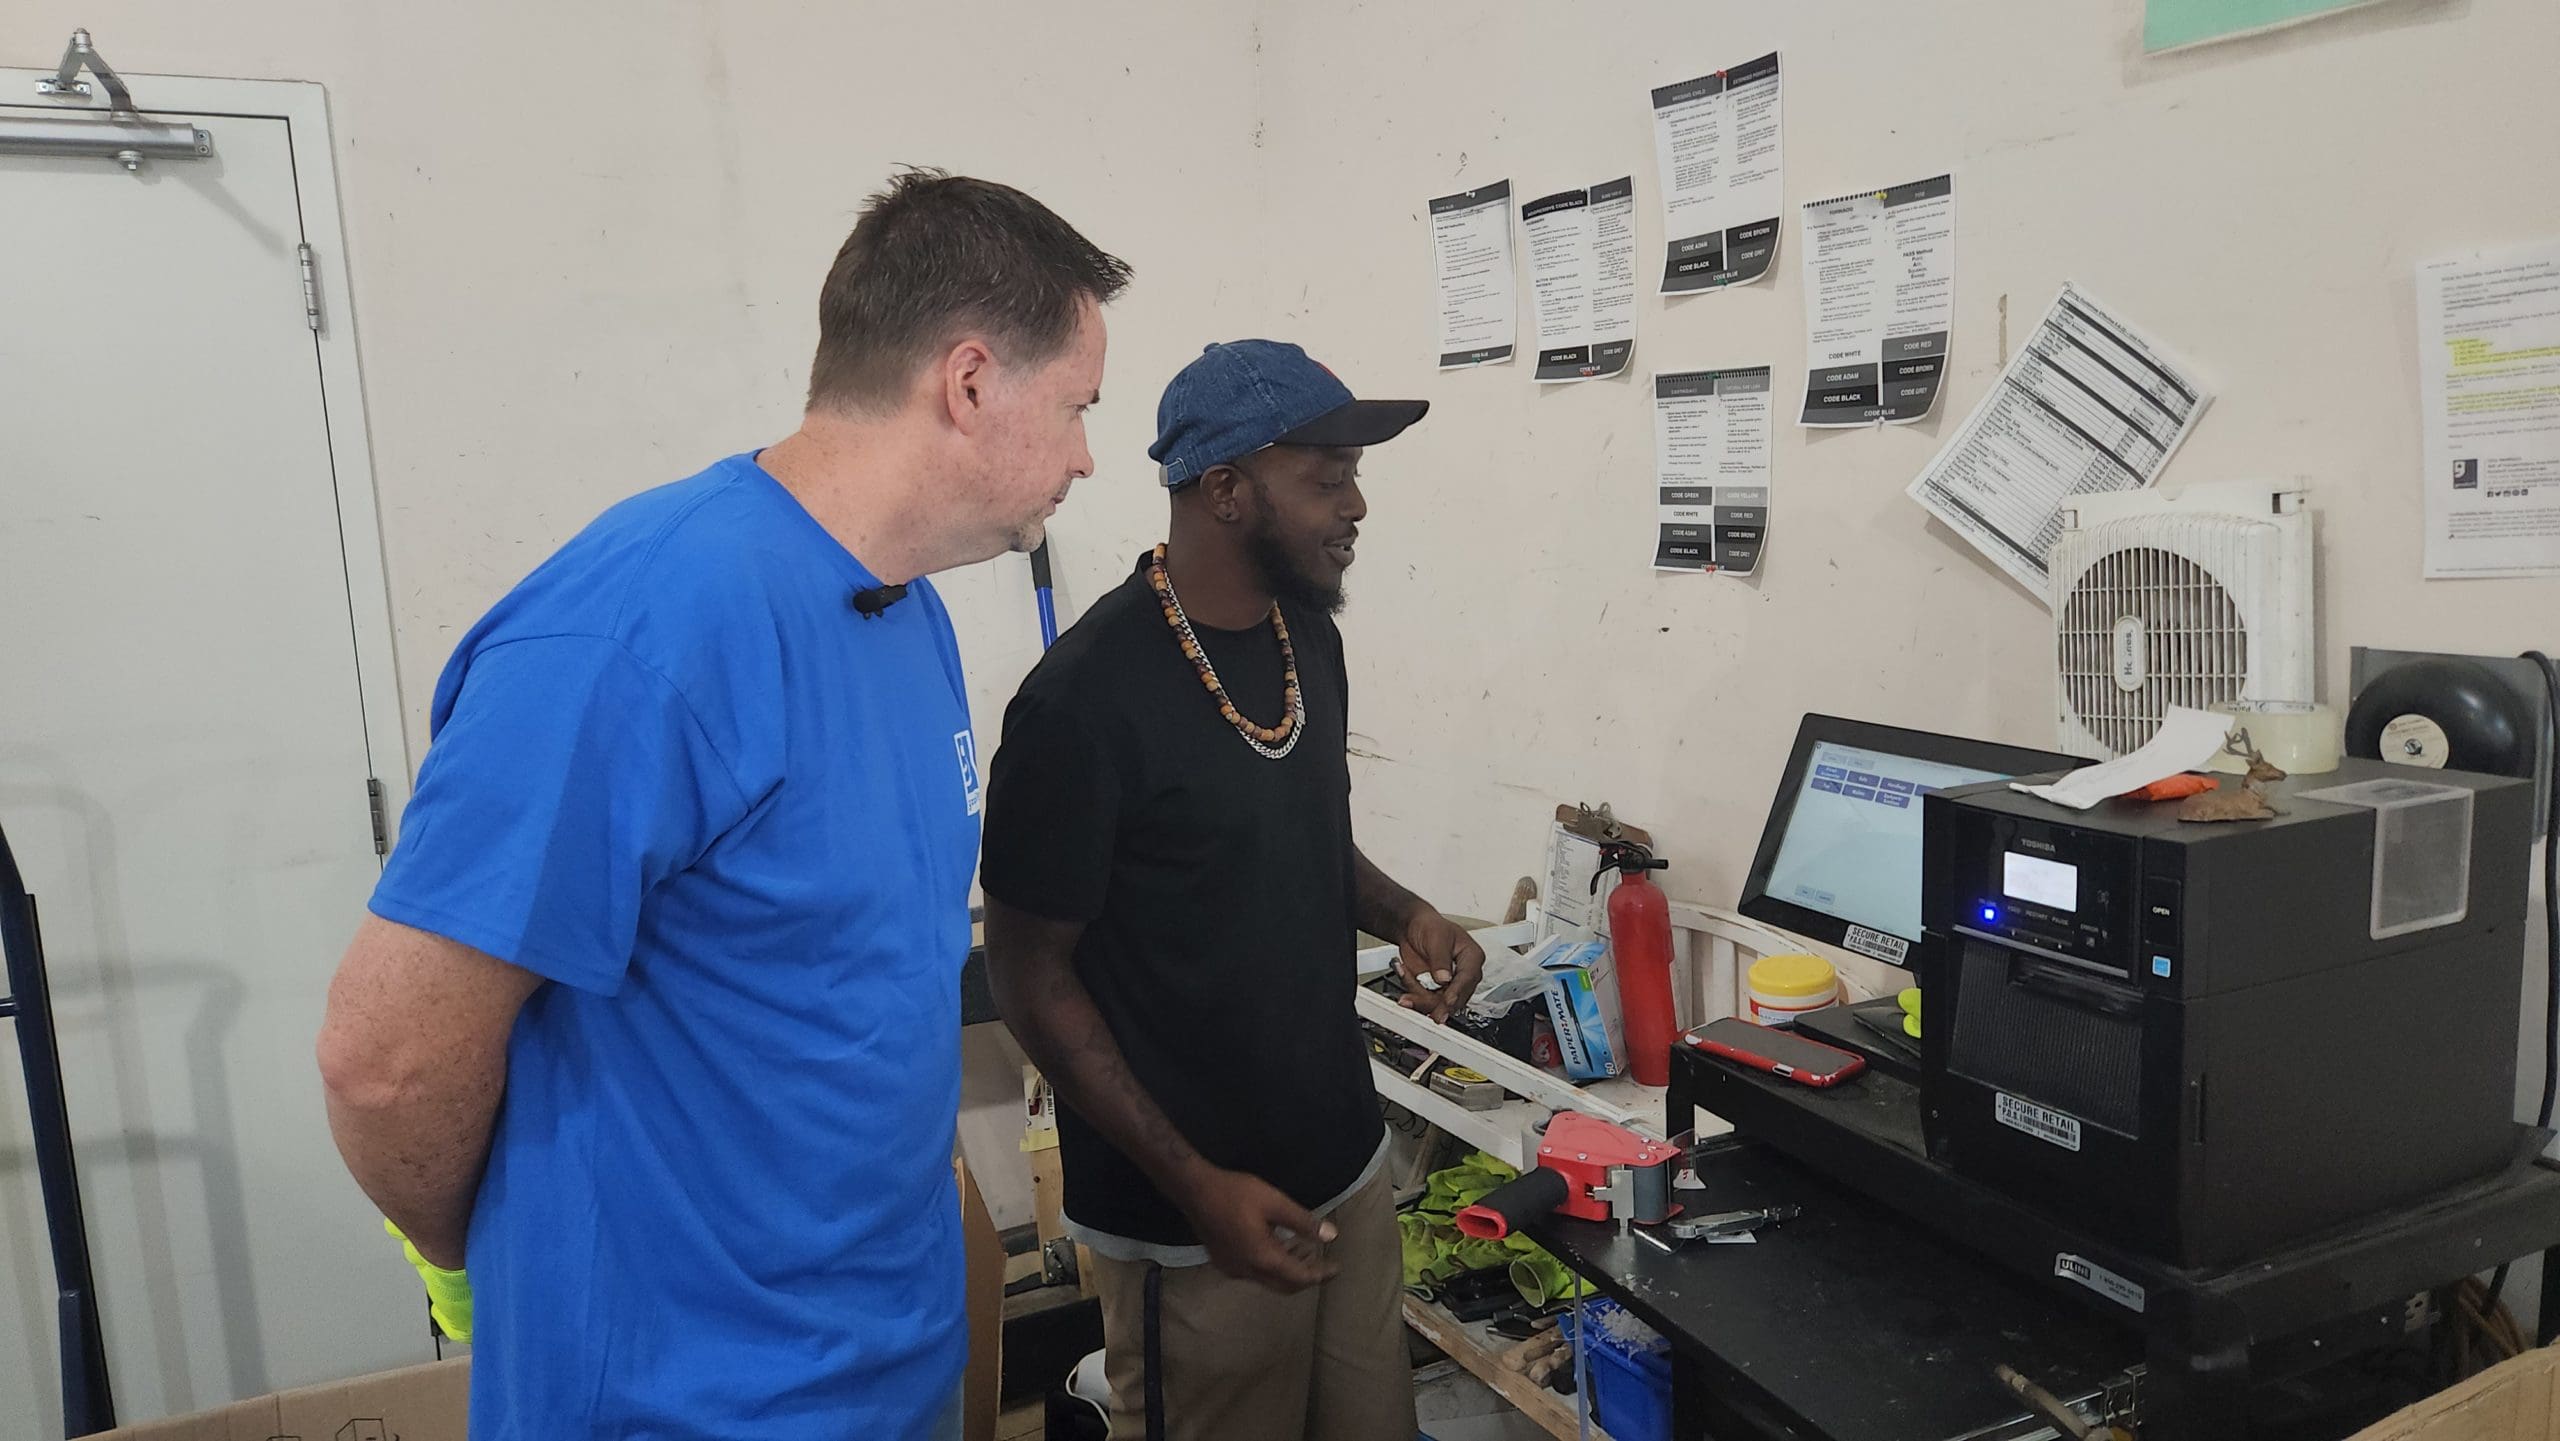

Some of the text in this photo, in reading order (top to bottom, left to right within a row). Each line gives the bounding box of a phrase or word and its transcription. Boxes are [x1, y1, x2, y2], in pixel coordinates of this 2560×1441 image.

[1739, 232, 1752, 240] CODE
[1681, 244, 1694, 252] CODE
[1679, 261, 1710, 272] CODE BLACK
[1921, 340, 1932, 348] RED
[1845, 350, 1861, 358] WHITE
[1916, 364, 1934, 373] BROWN
[1843, 372, 1859, 380] ADAM
[2021, 838, 2056, 853] TOSHIBA
[2026, 910, 2048, 920] RESTART
[2152, 906, 2170, 916] OPEN
[2052, 916, 2068, 926] PAUSE
[2081, 924, 2099, 933] ERROR
[1852, 927, 1880, 942] SECURE
[1881, 936, 1905, 951] RETAIL
[1604, 1062, 1616, 1075] 60
[2002, 1096, 2039, 1118] SECURE
[2043, 1111, 2076, 1133] RETAIL
[2061, 1260, 2089, 1279] ULINE
